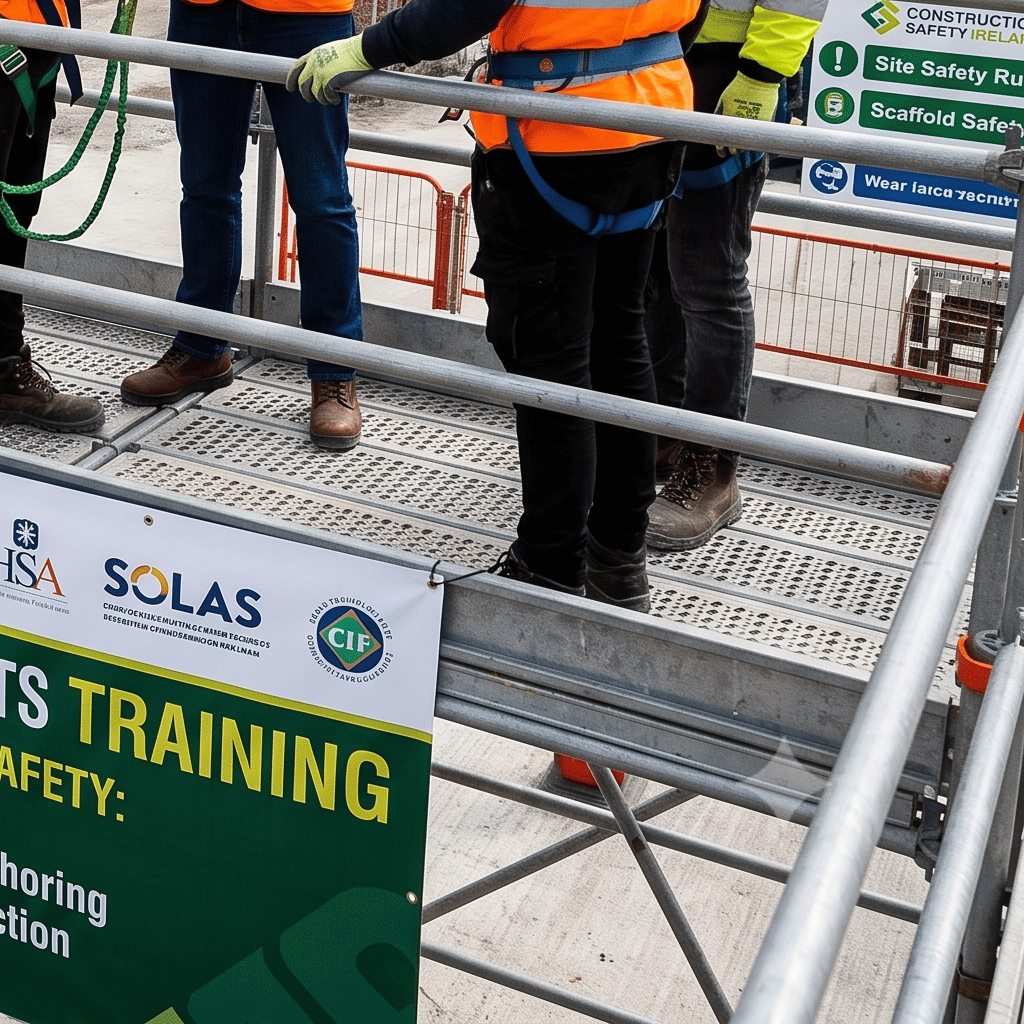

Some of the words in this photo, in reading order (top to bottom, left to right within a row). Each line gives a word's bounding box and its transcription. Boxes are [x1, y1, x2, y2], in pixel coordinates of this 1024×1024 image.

[905, 22, 968, 39] SAFETY
[875, 55, 915, 74] Site
[920, 60, 988, 86] Safety
[870, 102, 956, 127] Scaffold
[865, 174, 908, 192] Wear
[103, 557, 262, 629] SOLAS
[328, 627, 370, 653] CIF
[68, 676, 391, 825] TRAINING
